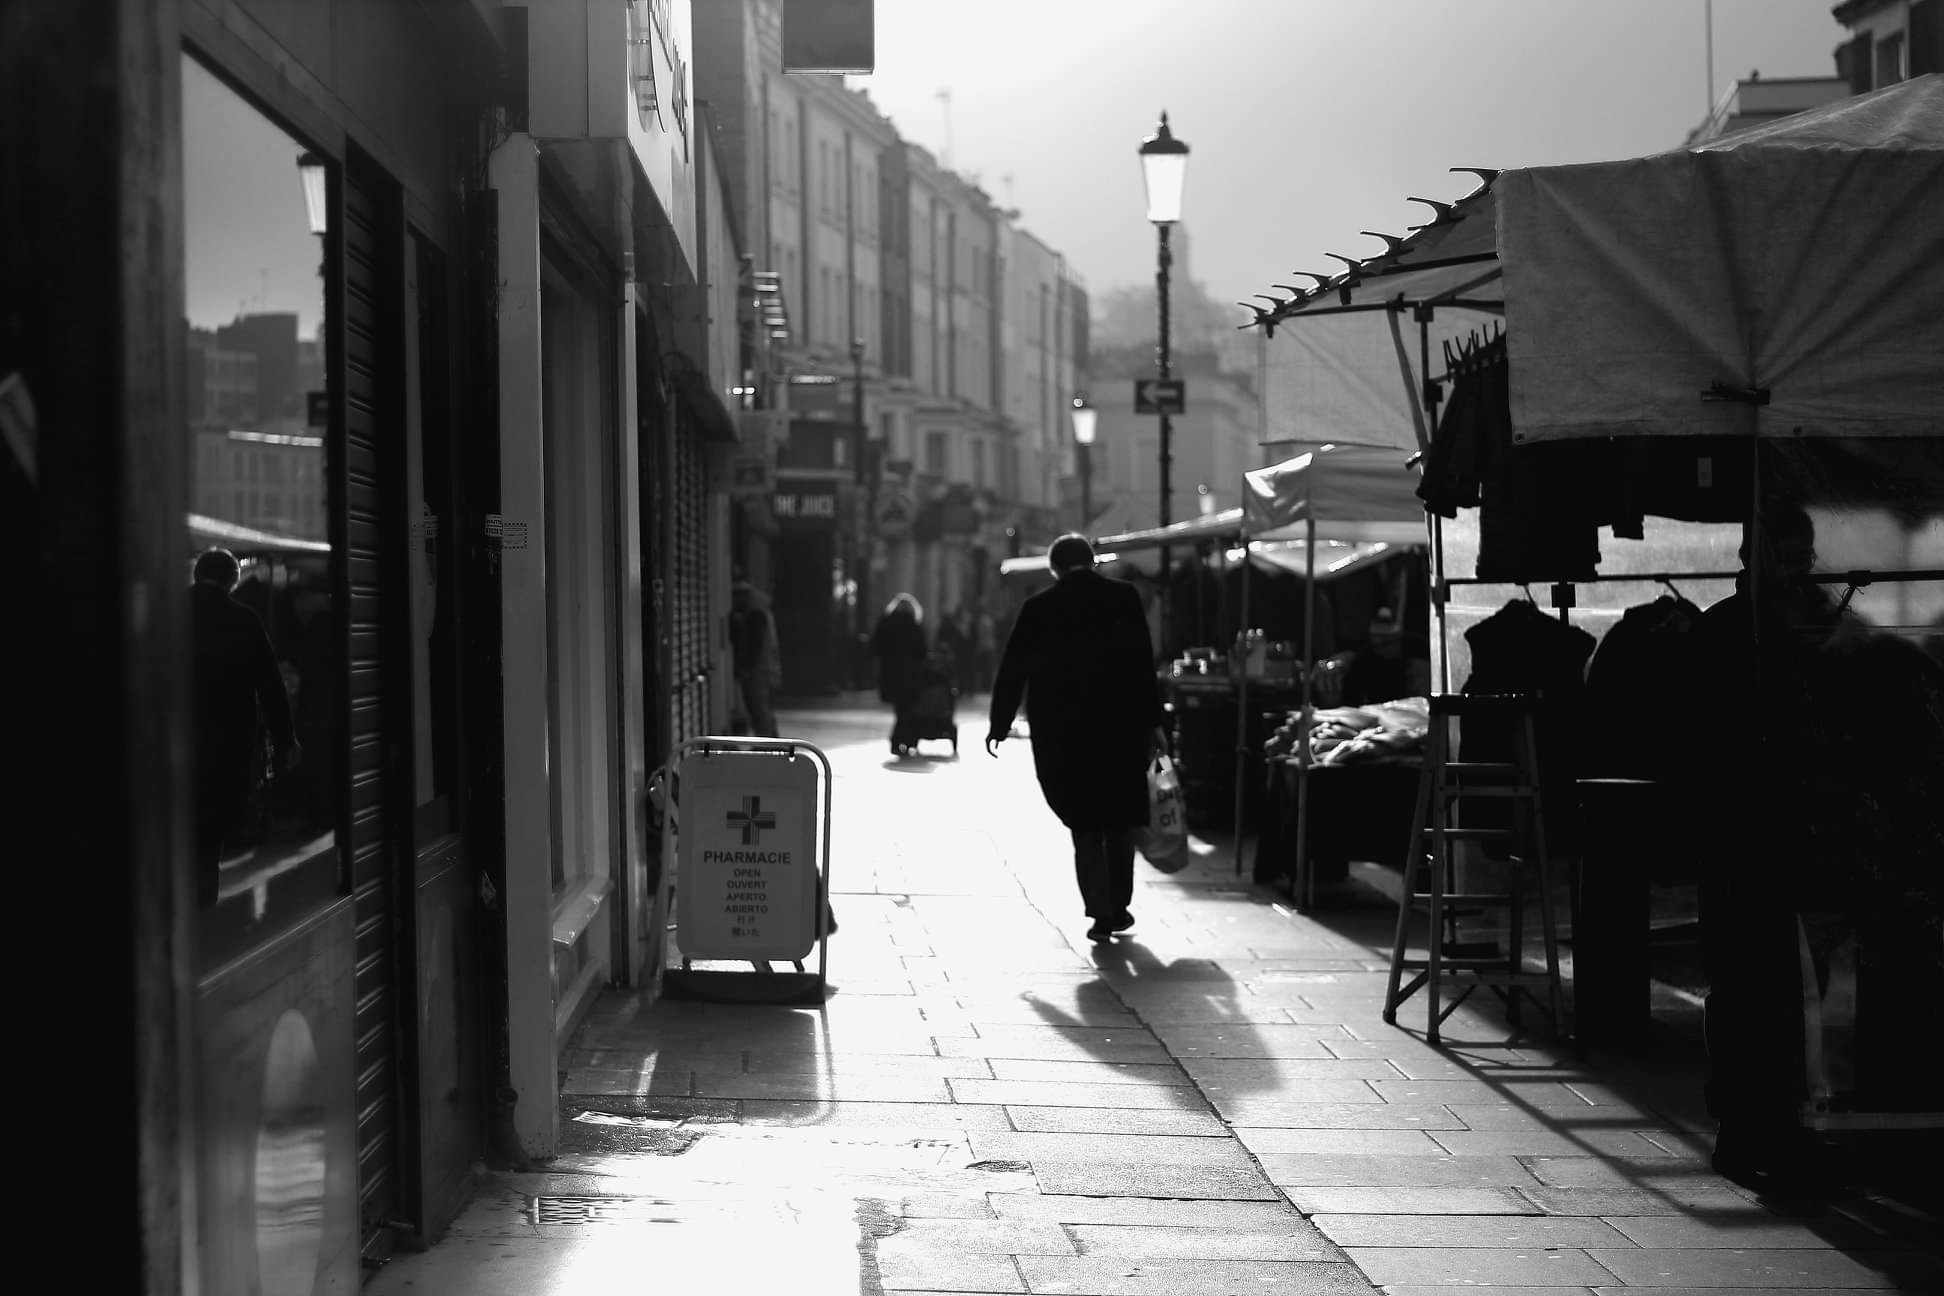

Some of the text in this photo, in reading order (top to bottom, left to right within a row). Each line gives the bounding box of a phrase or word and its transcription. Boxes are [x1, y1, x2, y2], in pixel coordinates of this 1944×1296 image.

[704, 850, 791, 864] PHARMACIE
[734, 868, 760, 877] OPEN
[727, 880, 767, 888] OUVERT
[726, 892, 767, 901] APERTO
[725, 904, 768, 913] ABIERTO
